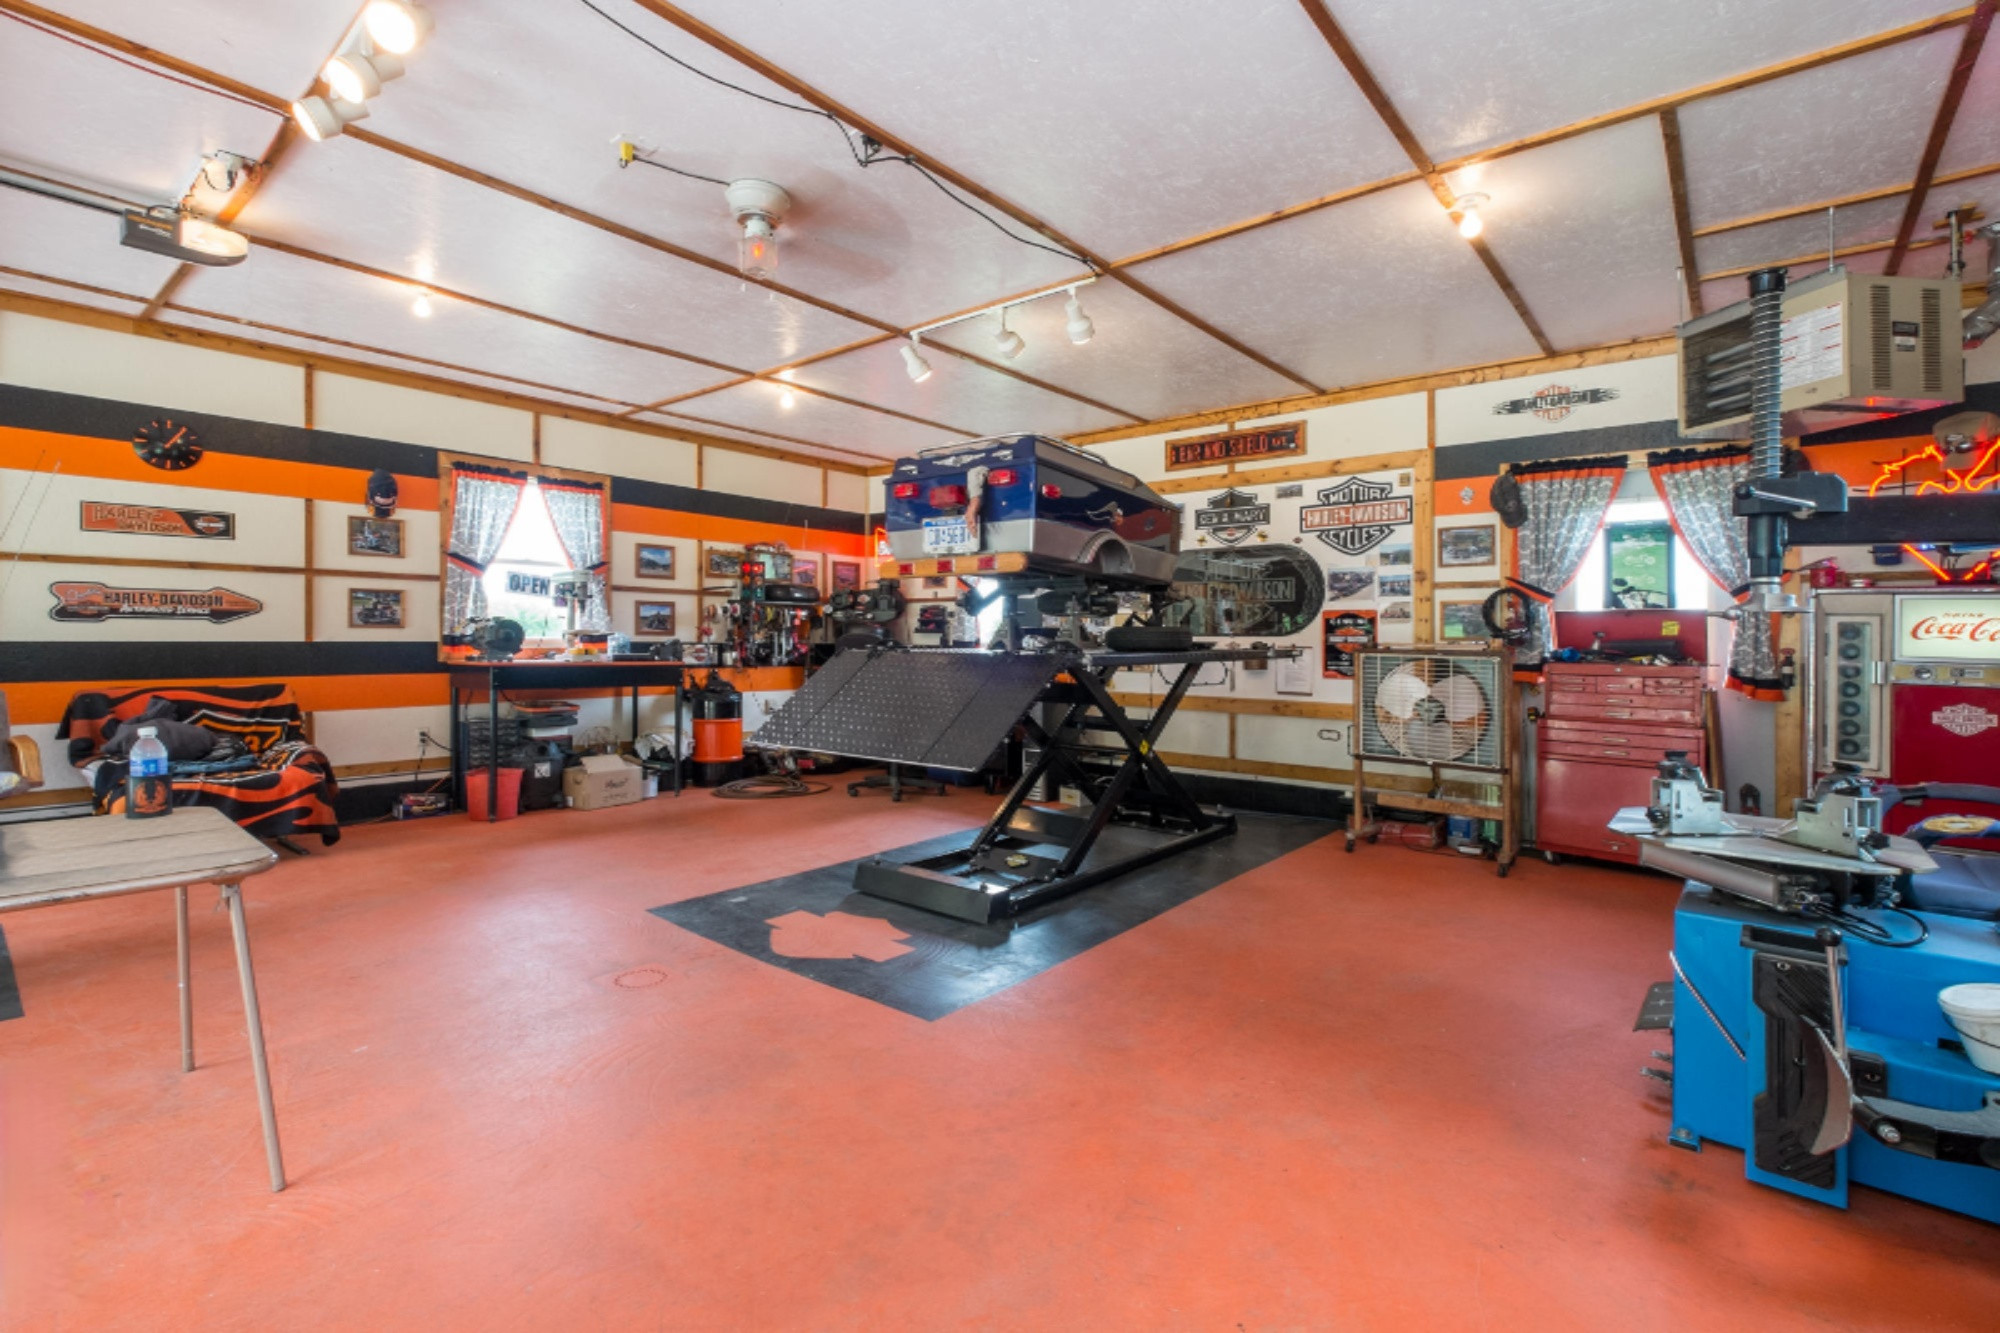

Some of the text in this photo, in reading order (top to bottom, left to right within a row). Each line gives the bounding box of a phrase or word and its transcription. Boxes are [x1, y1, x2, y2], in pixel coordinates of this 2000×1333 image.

[1229, 433, 1268, 456] SHIELD
[1306, 502, 1407, 528] HARLEY-DAVIDSON
[1328, 527, 1381, 549] CYCLES
[509, 573, 550, 595] OPEN
[103, 591, 223, 607] HARLEY-DAVIDSON
